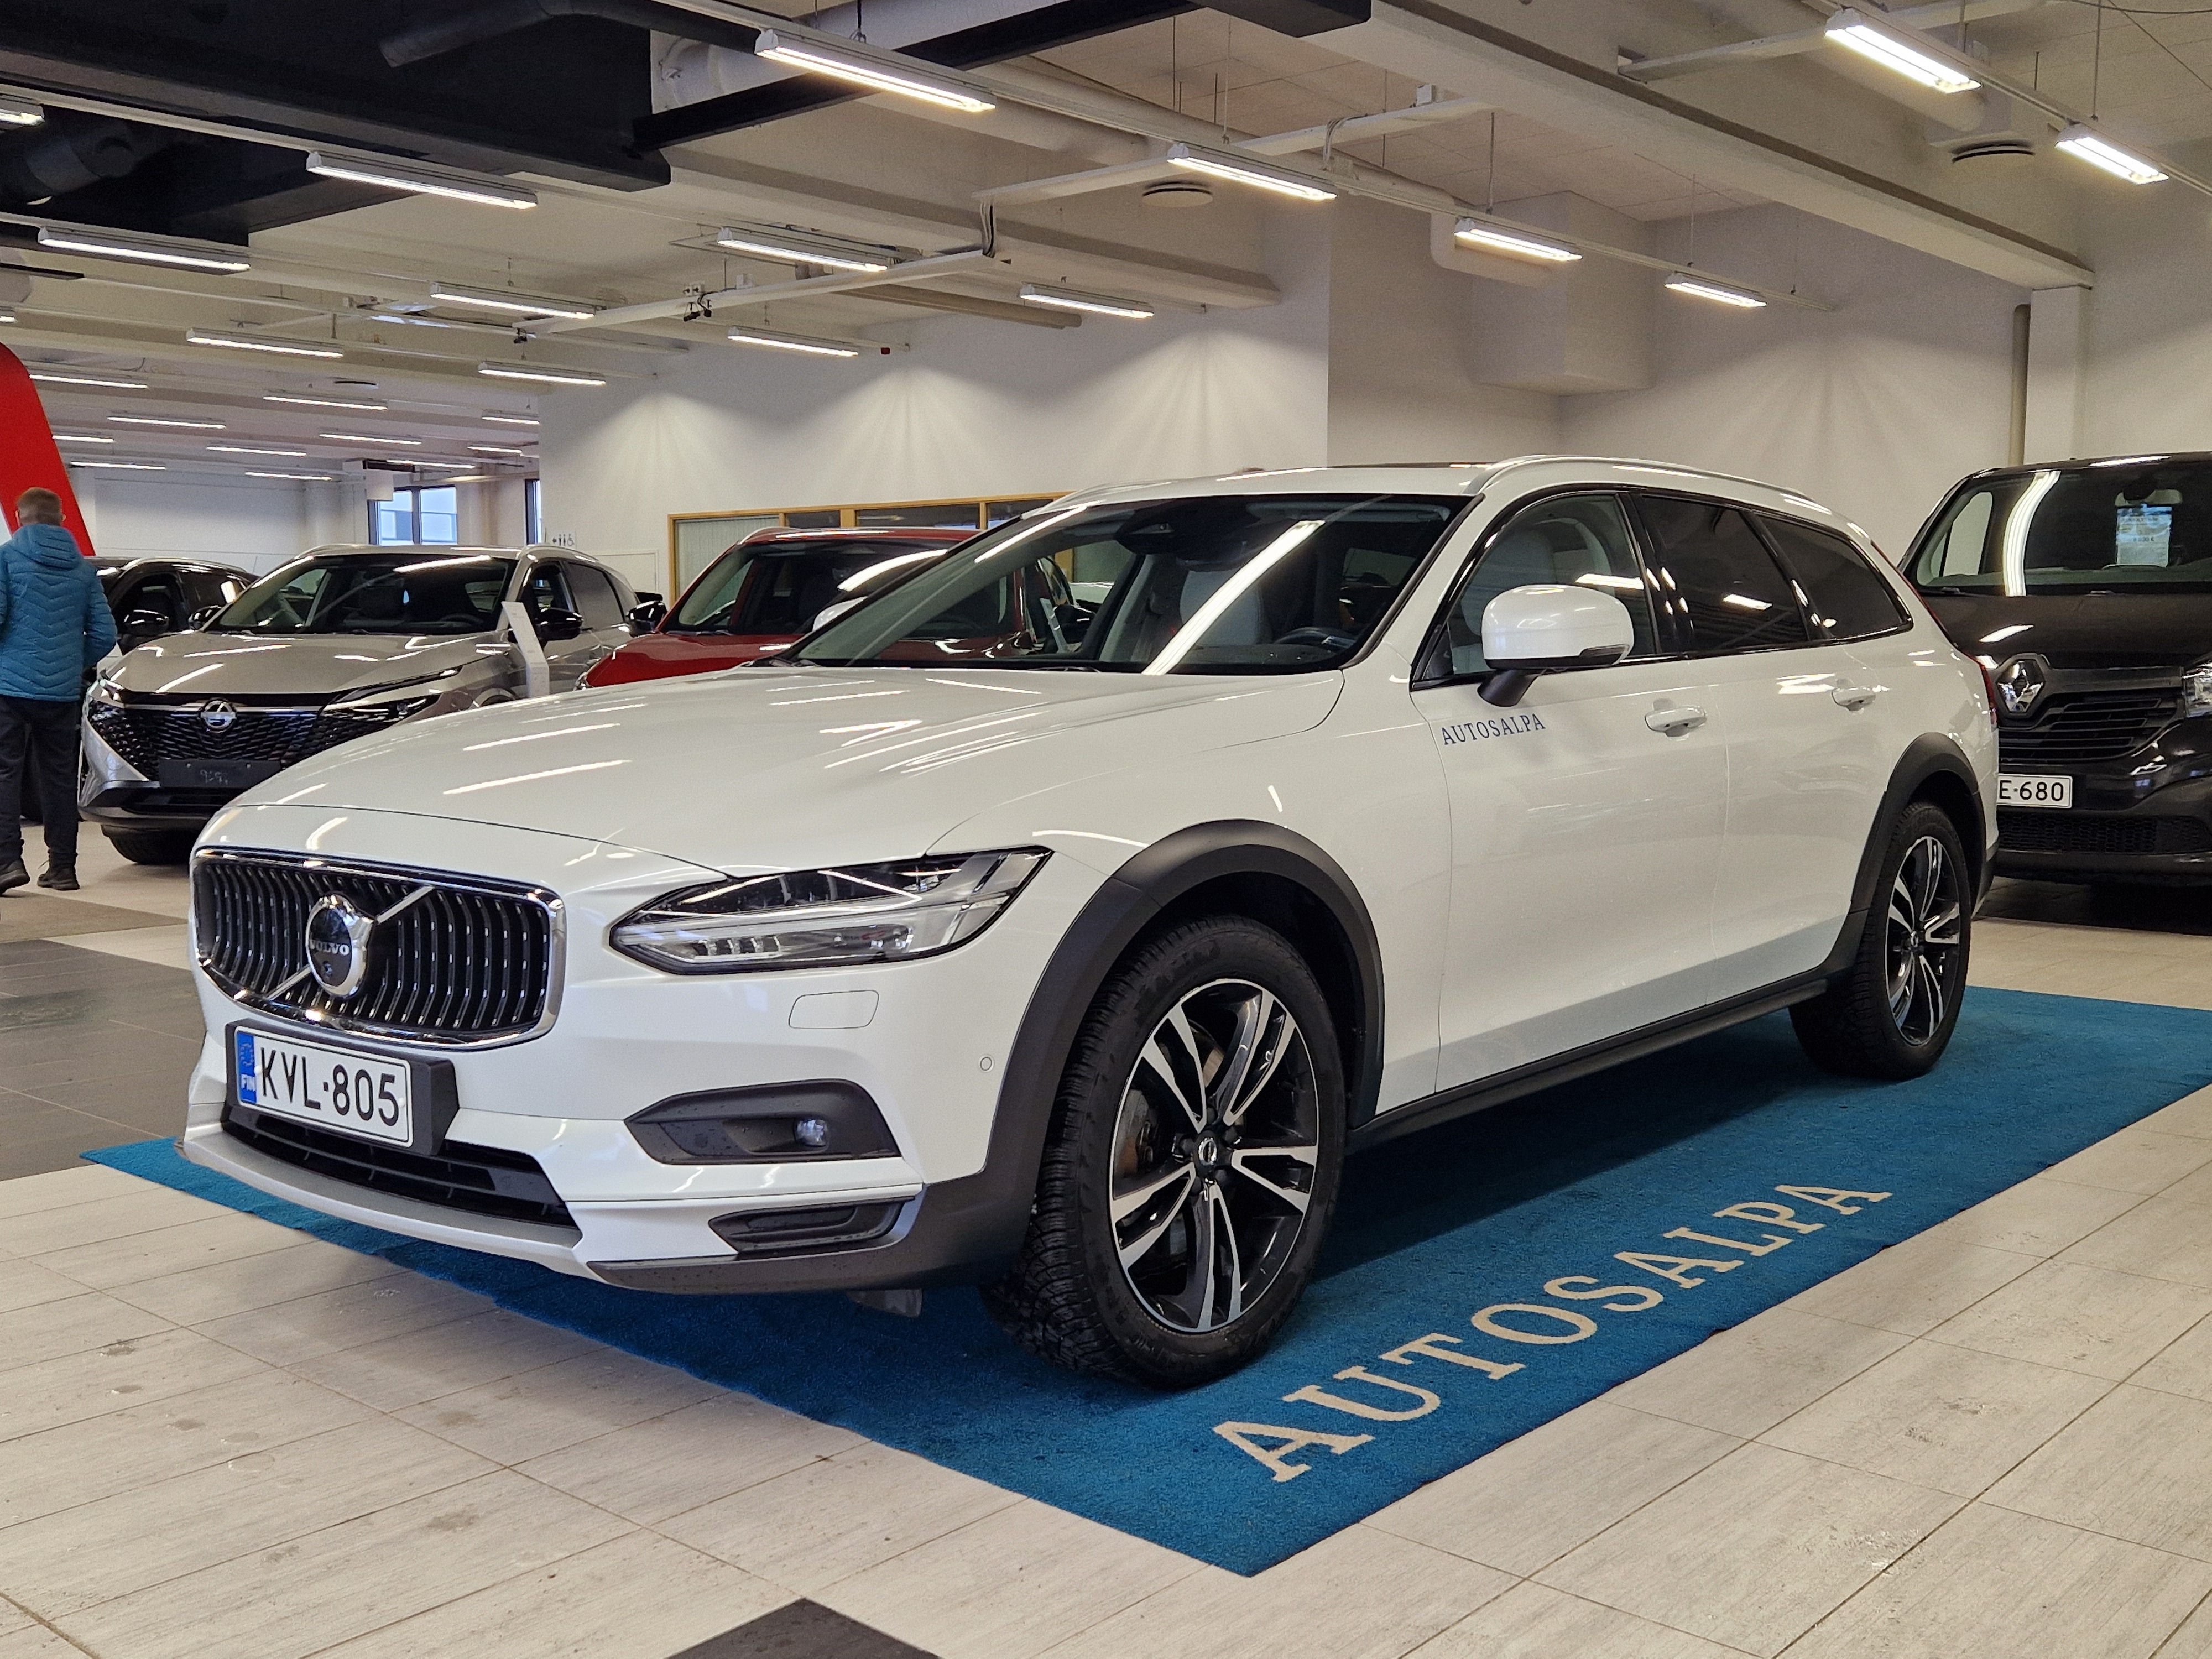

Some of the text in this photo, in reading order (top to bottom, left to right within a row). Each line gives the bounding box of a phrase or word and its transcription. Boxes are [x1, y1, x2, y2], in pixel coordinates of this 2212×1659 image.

[1441, 713, 1546, 745] AUTOSALPA
[310, 938, 350, 956] VOLVO
[241, 1073, 257, 1092] FIN
[260, 1047, 399, 1127] KVL-805
[1213, 1183, 1893, 1483] AUTOSALPA
